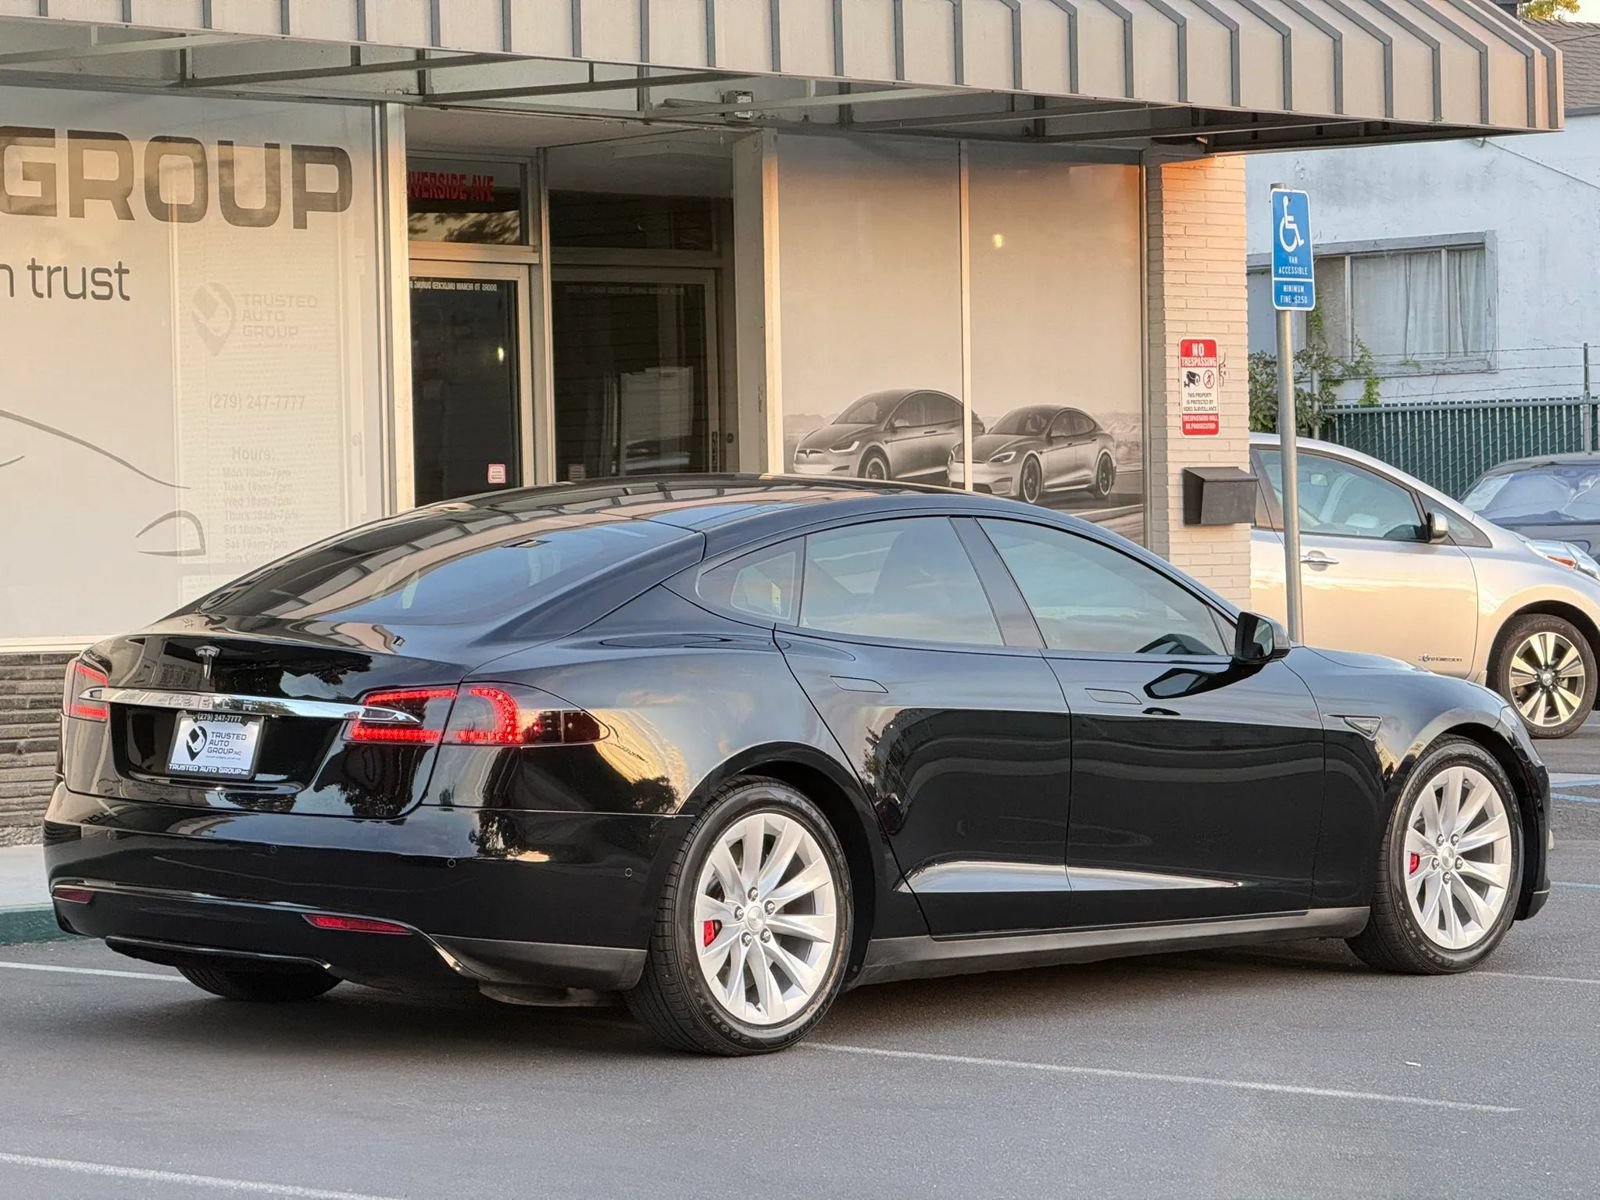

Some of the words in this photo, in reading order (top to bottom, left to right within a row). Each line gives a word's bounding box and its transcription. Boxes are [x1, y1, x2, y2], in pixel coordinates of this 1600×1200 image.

[0, 126, 353, 229] GROUP
[1288, 256, 1298, 264] VAN
[1278, 266, 1308, 275] ACCESSIBLE
[27, 257, 130, 301] trust
[1283, 284, 1304, 292] MINIMUM
[241, 294, 318, 308] TRUSTED
[1280, 295, 1292, 303] FINE
[241, 310, 285, 322] AUTO
[242, 325, 299, 338] GROUP
[1191, 343, 1205, 357] NO
[209, 393, 242, 412] (279)
[248, 394, 305, 409] 247-7777
[210, 731, 247, 741] TRUSTED
[207, 747, 234, 755] GROUP
[168, 763, 198, 773] TRUSTED
[218, 767, 241, 775] GROUP
